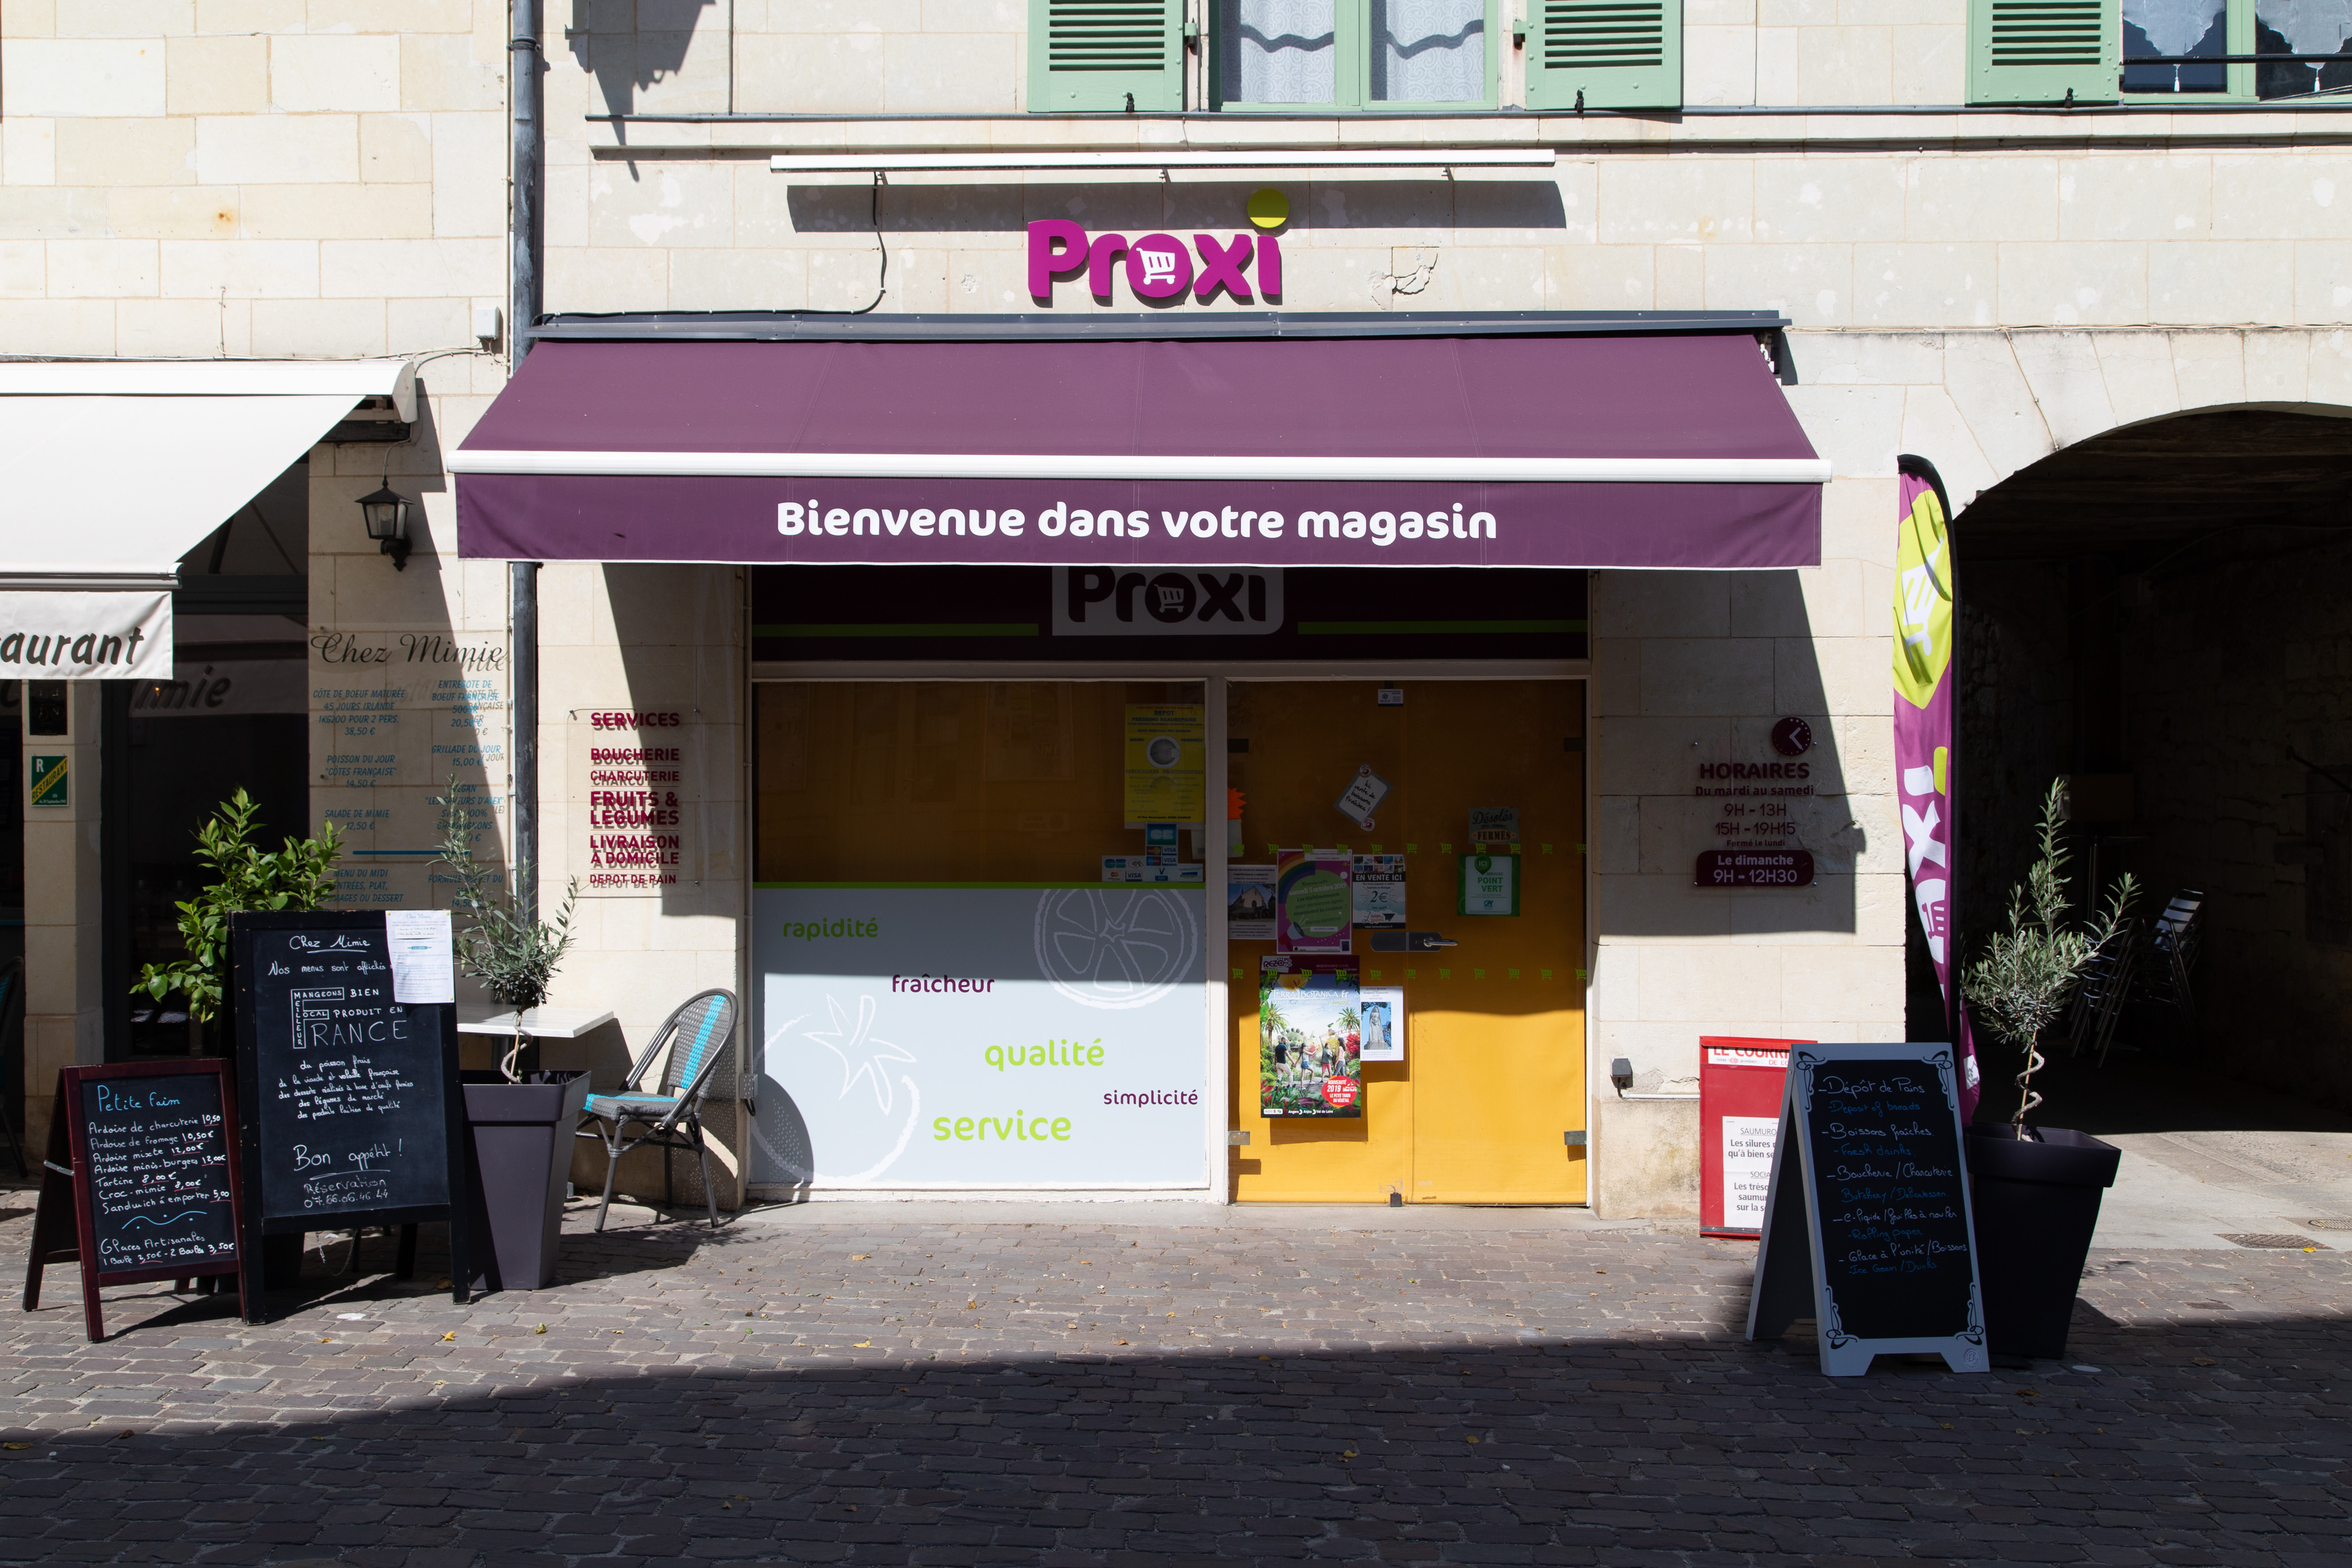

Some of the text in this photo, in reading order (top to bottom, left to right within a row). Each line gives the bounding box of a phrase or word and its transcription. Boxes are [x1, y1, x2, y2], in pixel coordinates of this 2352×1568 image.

[1027, 187, 1290, 304] Proxi
[776, 499, 1497, 546] Bienvenue dans votre magasin
[1067, 568, 1266, 624] Proxi
[0, 628, 144, 666] aurant
[310, 633, 509, 663] Chez Mimie
[314, 687, 332, 698] CÔTE
[334, 690, 345, 698] DE
[346, 690, 369, 698] BOEUF
[370, 687, 405, 698] MATURÉE
[458, 693, 498, 703] FRANÇAISE
[323, 702, 394, 710] 45 JOURS IRLANDE
[318, 715, 399, 723] 1KG200 POUR 2 PERS.
[451, 719, 474, 728] 20,50
[591, 713, 679, 727] SERVICES
[345, 727, 376, 736] 38,50 €
[327, 755, 394, 764] POISSON DU JOUR
[591, 748, 679, 761] BOUCHERIE
[36, 758, 44, 772] R
[452, 758, 474, 766] 15,00
[591, 771, 679, 781] CHARCUTERIE
[1700, 762, 1810, 779] HORAIRES
[32, 759, 68, 799] RESTAURANT
[1351, 789, 1371, 805] boissons
[1355, 785, 1368, 795] vente
[1696, 785, 1814, 795] Du mardi au samedi
[590, 791, 678, 807] FRUITS &
[1345, 795, 1365, 811] fraîches
[325, 810, 389, 818] SALADE DE MIMIE
[590, 810, 679, 824] LEGUMES
[1472, 808, 1512, 824] Désolés
[1724, 804, 1744, 816] 9H
[1760, 804, 1786, 816] 13H
[346, 822, 375, 831] 12,50 €
[1715, 822, 1739, 835] 15H
[1754, 822, 1796, 835] 19H15
[590, 835, 679, 849] LIVRAISON
[591, 852, 679, 864] A DOMICILE
[1718, 855, 1794, 865] Le dimanche
[333, 869, 388, 877] MENU DU MIDI
[590, 874, 676, 883] DEPOT DE PAIN
[1713, 870, 1734, 882] 9H
[1749, 870, 1797, 882] 12H30
[783, 917, 879, 942] rapidité
[289, 935, 370, 950] Chez Mimie
[268, 961, 289, 975] Nos
[331, 961, 349, 971] sont
[357, 961, 386, 975] affichés
[892, 973, 995, 993] fraîcheur
[294, 989, 379, 999] MANGEONS BIEN
[334, 1008, 381, 1017] PRODUIT
[984, 1037, 1105, 1071] qualité
[1735, 1048, 1788, 1058] COURRI
[319, 1055, 370, 1073] poisson frais
[1880, 1077, 1925, 1093] de Pains
[98, 1085, 142, 1112] Petite
[1103, 1089, 1198, 1108] simplicité
[1872, 1101, 1920, 1117] of breads
[89, 1114, 220, 1135] Ardoise de charcuterie 10,50
[933, 1110, 1071, 1141] service
[91, 1137, 141, 1150] Ardoise de
[1731, 1139, 1770, 1147] Les silures
[93, 1148, 164, 1163] Ardoise mixte
[293, 1144, 391, 1171] Bon appétit
[1747, 1149, 1764, 1157] bien
[96, 1177, 133, 1187] Tartine
[304, 1175, 386, 1194] Réservation
[145, 1232, 204, 1248] Artisanales
[1893, 1229, 1922, 1240] paper
